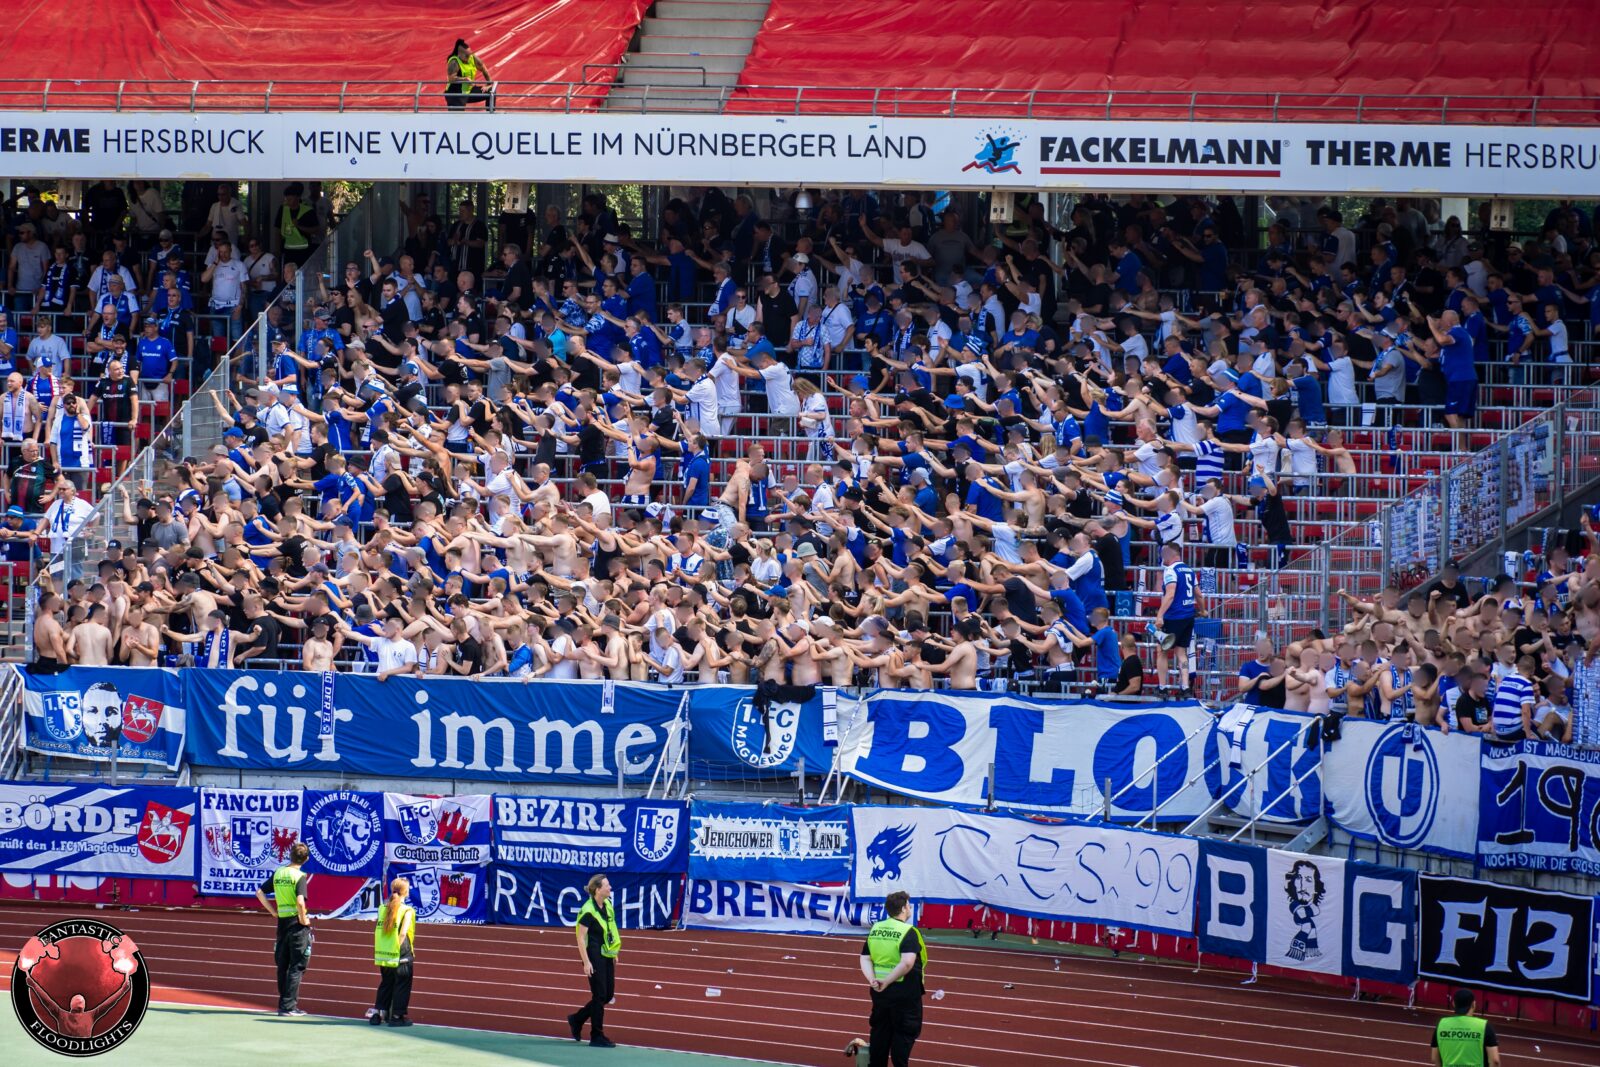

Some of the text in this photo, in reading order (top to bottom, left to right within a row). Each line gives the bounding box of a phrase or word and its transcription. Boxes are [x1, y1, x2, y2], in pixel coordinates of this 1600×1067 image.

[0, 127, 265, 154] ERME HERSBRUCK
[295, 127, 927, 160] MEINE VITALQUELLE IM NÜRNBERGER LAND
[1040, 136, 1600, 170] FACKELMANN THERME HERSBRU
[216, 675, 692, 776] für immer
[735, 725, 793, 765] MAGDEBURG
[1489, 744, 1516, 759] NOCH
[1523, 739, 1539, 754] IST
[854, 699, 1334, 822] BLOCK
[202, 793, 299, 812] FANCLUB
[340, 792, 350, 801] IST
[1495, 759, 1600, 853] 19
[0, 795, 138, 835] BÖRDE
[233, 818, 269, 836] 1.FC
[496, 797, 627, 833] BEZIRK
[640, 813, 674, 829] 1.FC
[403, 819, 437, 844] MAGDEBURG
[637, 831, 674, 860] MAGDEBURG
[26, 838, 47, 850] den
[77, 841, 139, 857] Magdeburg
[232, 840, 272, 866] MAGDEBURG
[347, 840, 380, 872] MAGDEBURG
[498, 845, 625, 867] NEUNUNDDREISSIG
[1484, 852, 1517, 867] NOCH
[1529, 855, 1547, 869] WIR
[1550, 857, 1568, 871] DIE
[494, 869, 672, 929] RAGHN
[689, 879, 863, 927] BREMEN
[1206, 853, 1407, 970] B G
